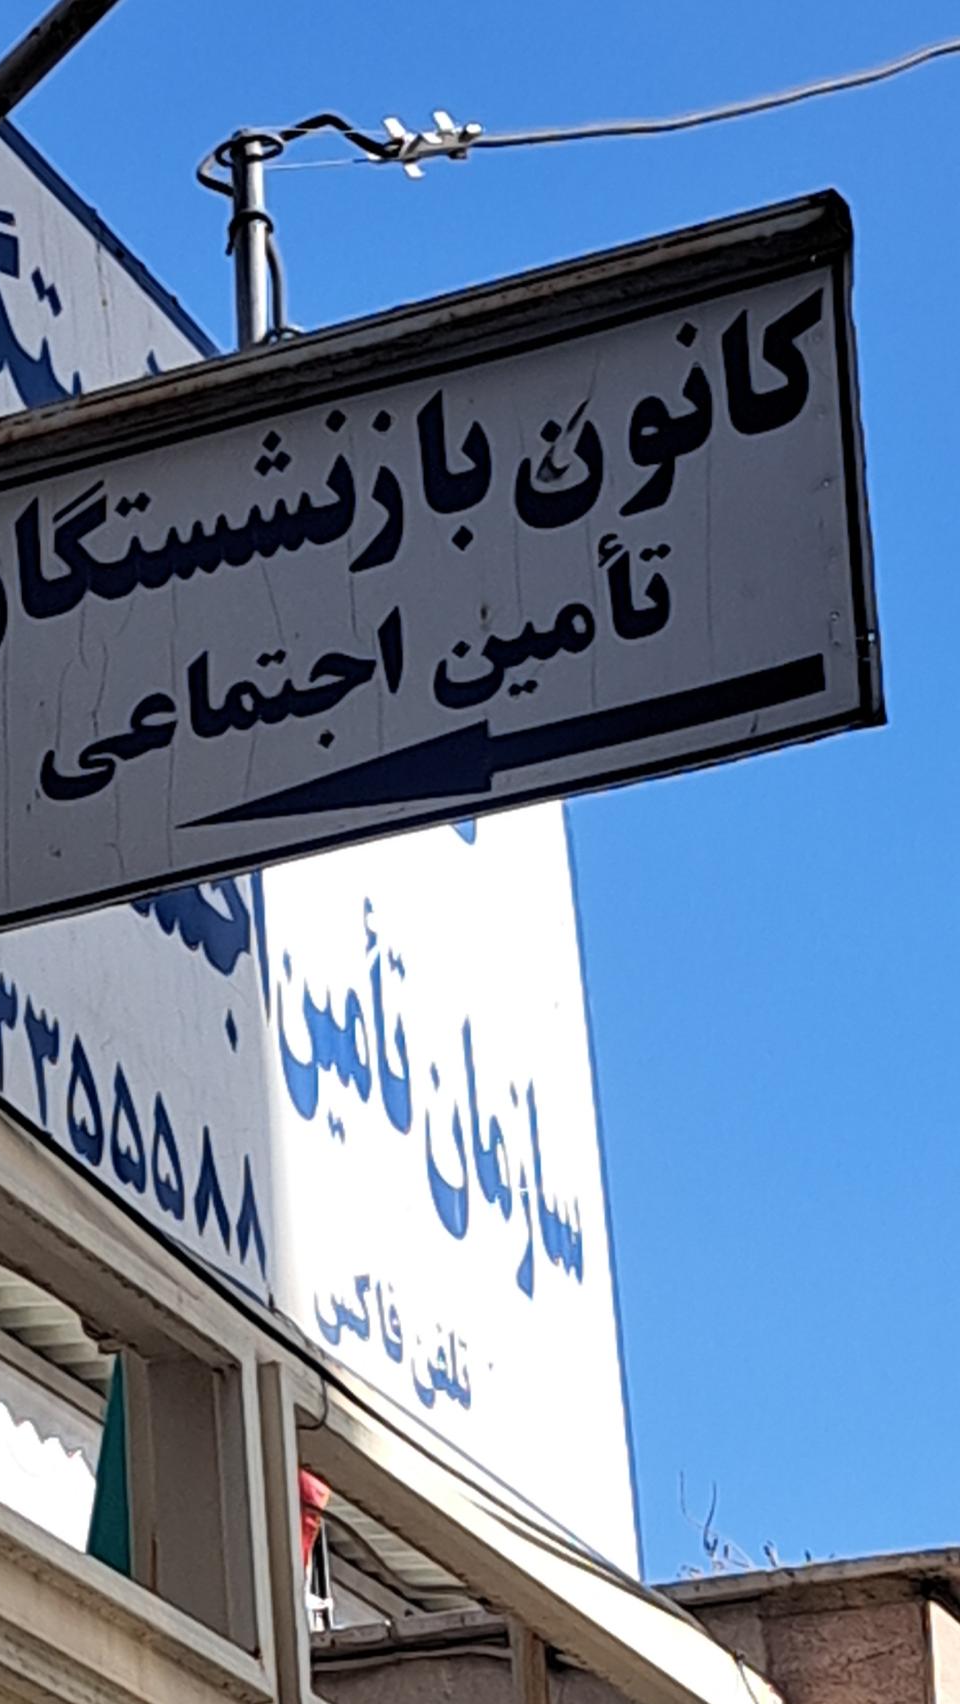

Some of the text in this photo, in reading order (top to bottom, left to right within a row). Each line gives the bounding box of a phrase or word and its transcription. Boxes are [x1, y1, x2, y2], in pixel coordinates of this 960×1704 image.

[514, 287, 825, 530] کانون
[40, 605, 404, 800] اجتماعی
[432, 532, 672, 709] تأمین
[276, 895, 413, 1144] تأمین
[425, 1014, 584, 1301] سازمان
